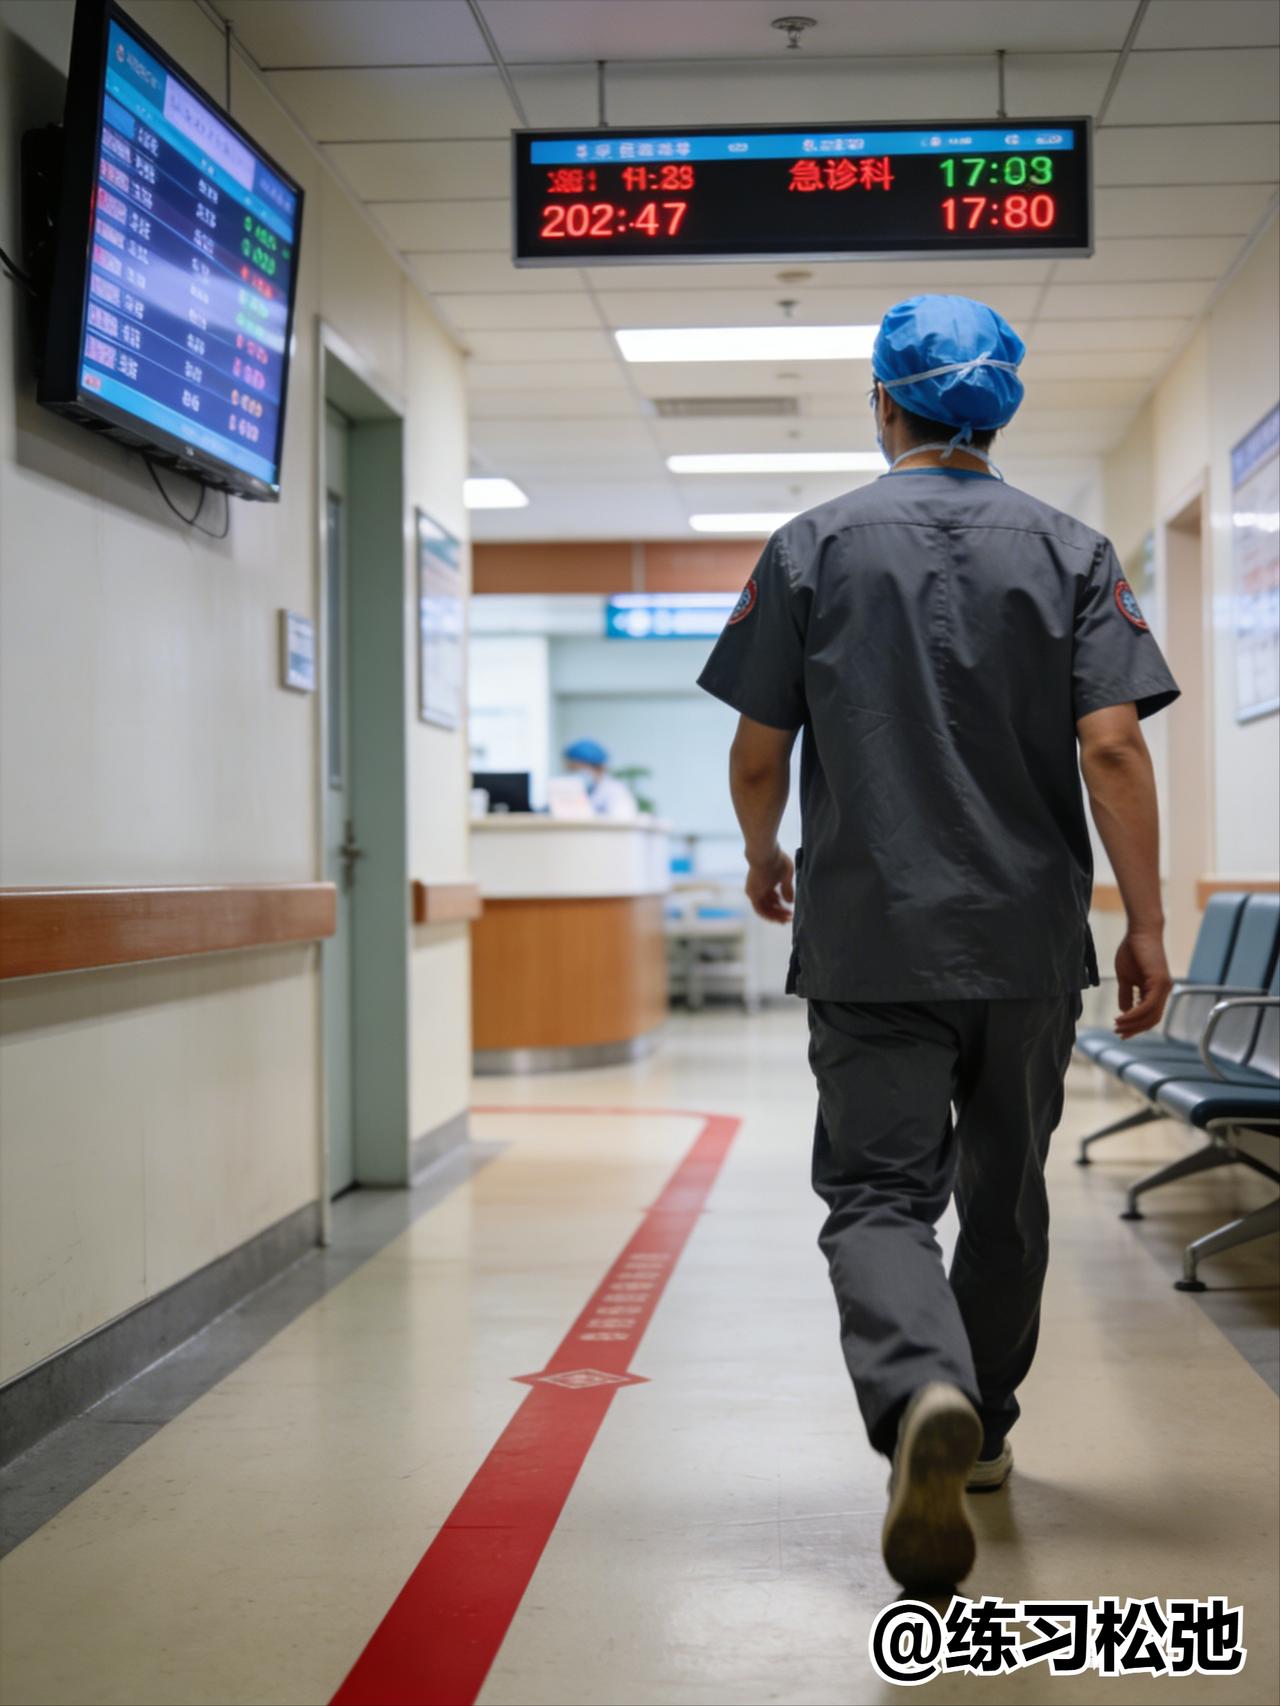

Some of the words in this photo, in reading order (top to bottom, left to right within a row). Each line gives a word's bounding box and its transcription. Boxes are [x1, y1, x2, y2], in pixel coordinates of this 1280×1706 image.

[789, 156, 894, 192] 急诊科
[942, 194, 1056, 230] 17:80
